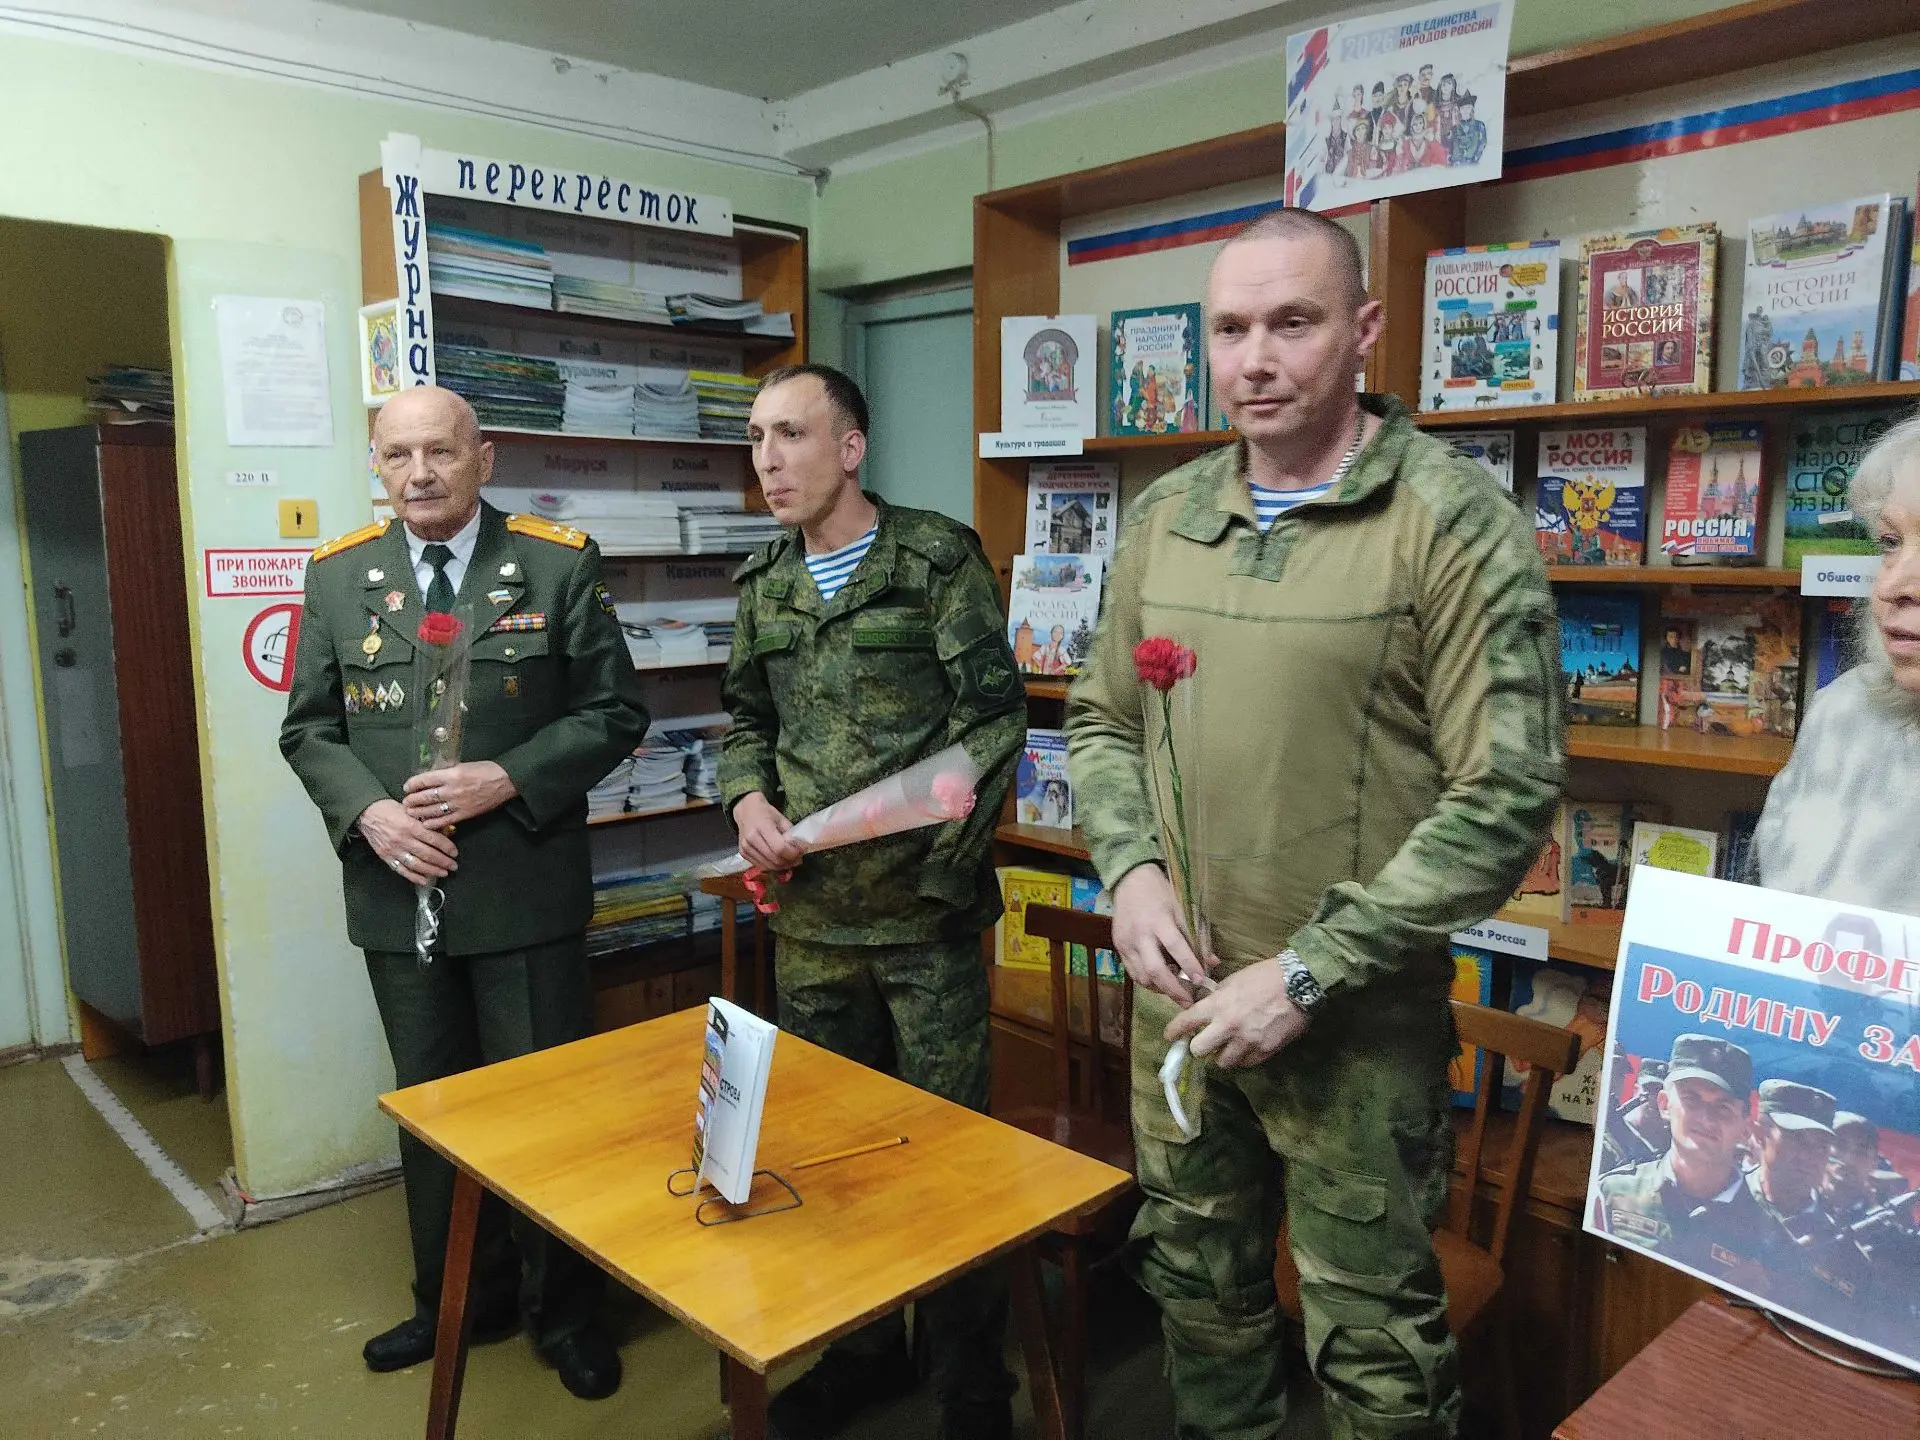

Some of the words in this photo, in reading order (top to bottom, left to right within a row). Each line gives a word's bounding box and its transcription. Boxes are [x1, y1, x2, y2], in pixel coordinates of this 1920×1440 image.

[1399, 31, 1448, 49] НАРОДОВ
[1450, 18, 1493, 38] РОССИИ
[1400, 23, 1421, 38] ГОД
[1424, 10, 1478, 32] ЕДИНСТВА
[457, 157, 700, 225] перекрёсток
[1435, 263, 1460, 276] НАША
[1461, 260, 1493, 274] РОДИНА
[394, 172, 429, 386] Журна
[1434, 274, 1499, 298] РОССИЯ
[1768, 271, 1857, 296] ИСТОРИЯ
[1772, 288, 1849, 310] РОССИИ
[1602, 303, 1684, 324] ИСТОРИЯ
[1130, 323, 1181, 335] ПРАЗДНИКИ
[1602, 316, 1684, 338] РОССИИ
[1135, 333, 1175, 343] НАРОДОВ
[1137, 342, 1173, 351] РОССИИ
[560, 364, 618, 380] туралист
[1566, 431, 1614, 450] МОЯ
[1548, 448, 1633, 467] РОССИЯ
[235, 472, 255, 483] 220
[1665, 518, 1751, 538] РОССИЯ,
[216, 558, 245, 572] ПРИ
[248, 557, 304, 571] ПОЖАРЕ
[232, 574, 293, 588] ЗВОНИТЬ
[1487, 929, 1527, 946] России
[1637, 963, 1841, 1047] РОДИНУ
